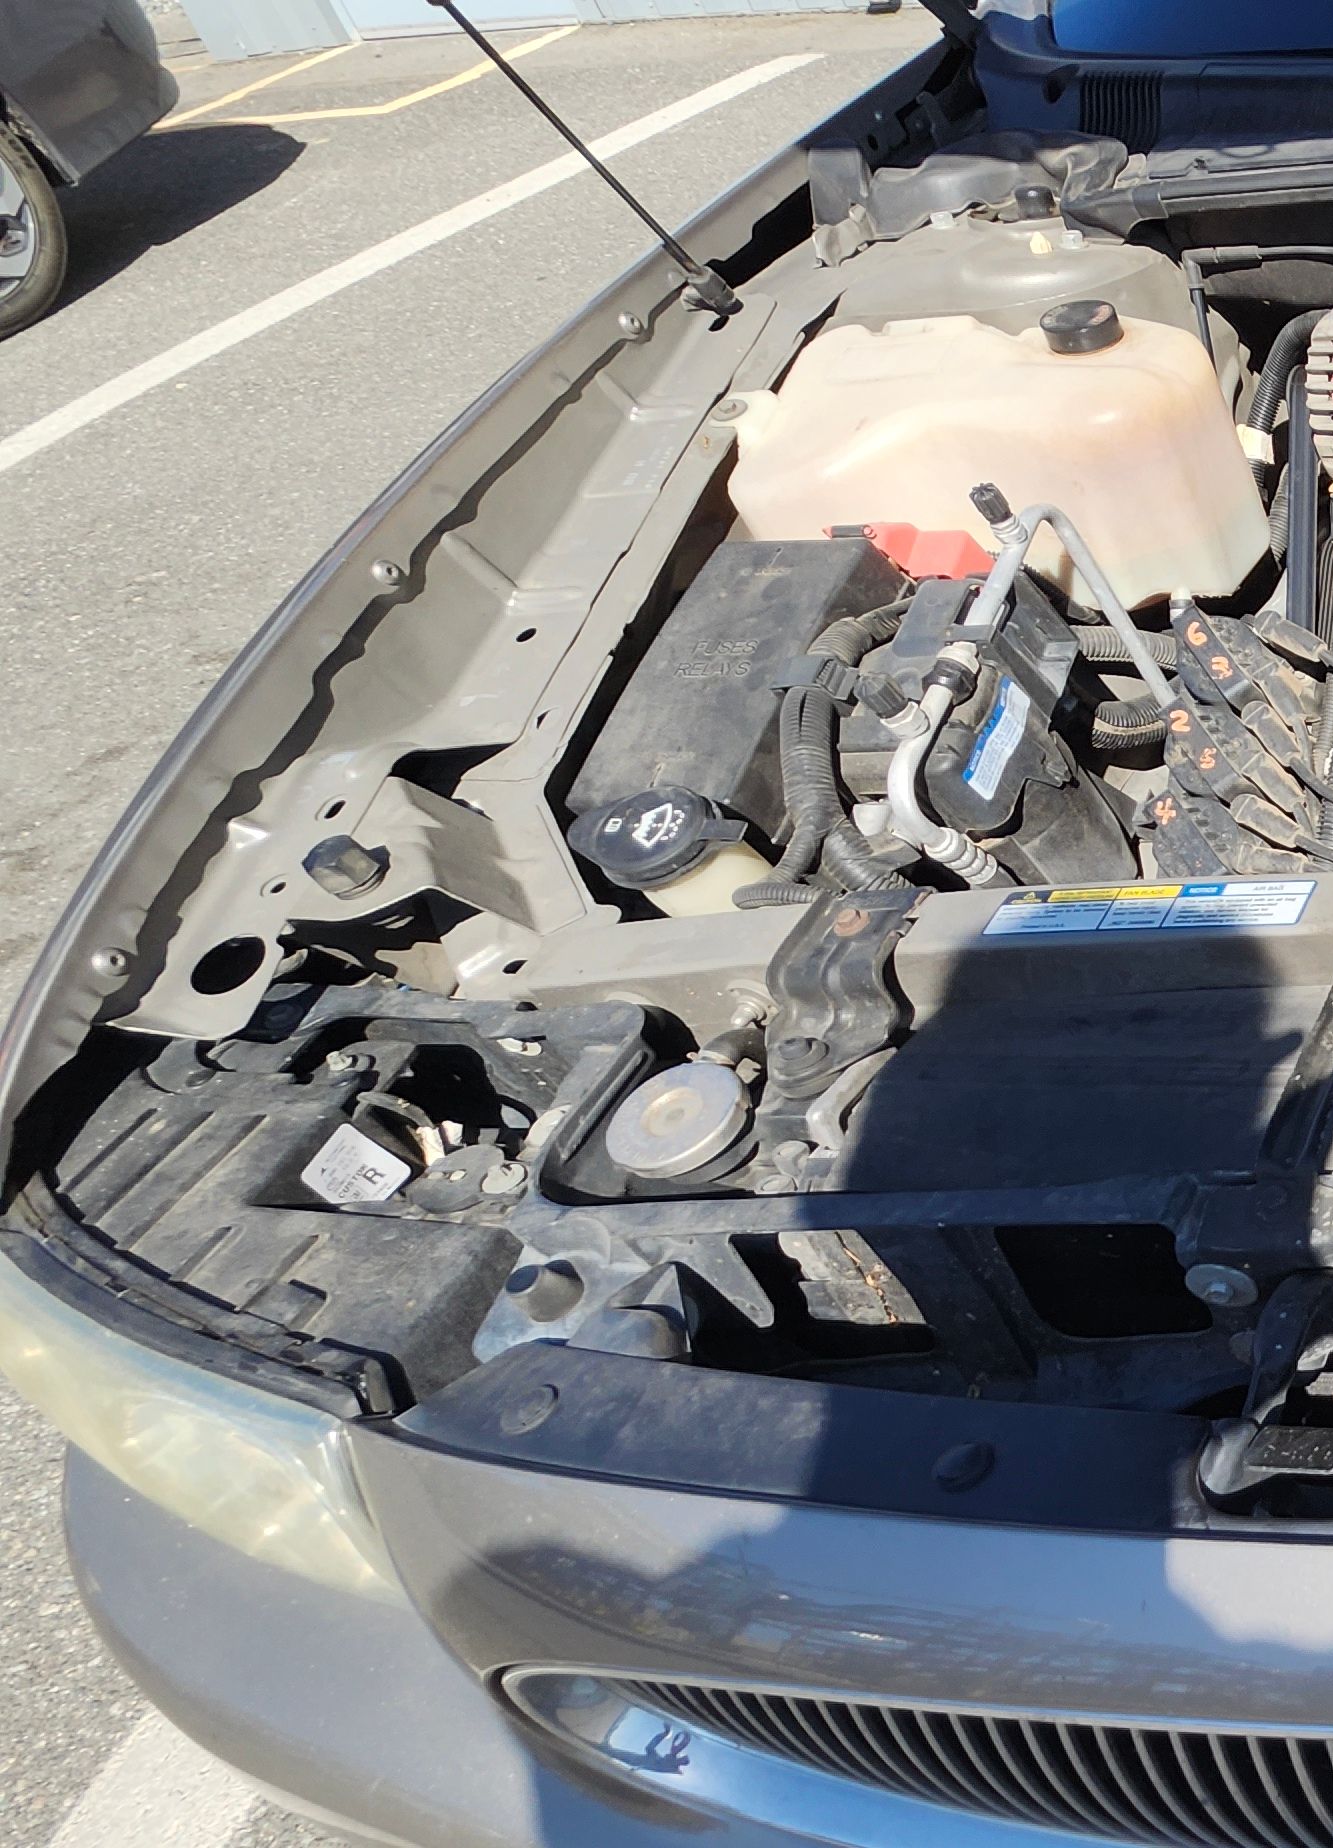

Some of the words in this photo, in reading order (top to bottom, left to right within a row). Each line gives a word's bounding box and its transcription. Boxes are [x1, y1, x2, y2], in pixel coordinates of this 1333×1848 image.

[1187, 621, 1207, 646] 6
[692, 639, 759, 656] FUSES
[673, 660, 752, 677] RELAYS
[1169, 709, 1190, 732] 2
[1200, 747, 1217, 769] 5
[1154, 798, 1176, 825] 4
[362, 1166, 386, 1186] R
